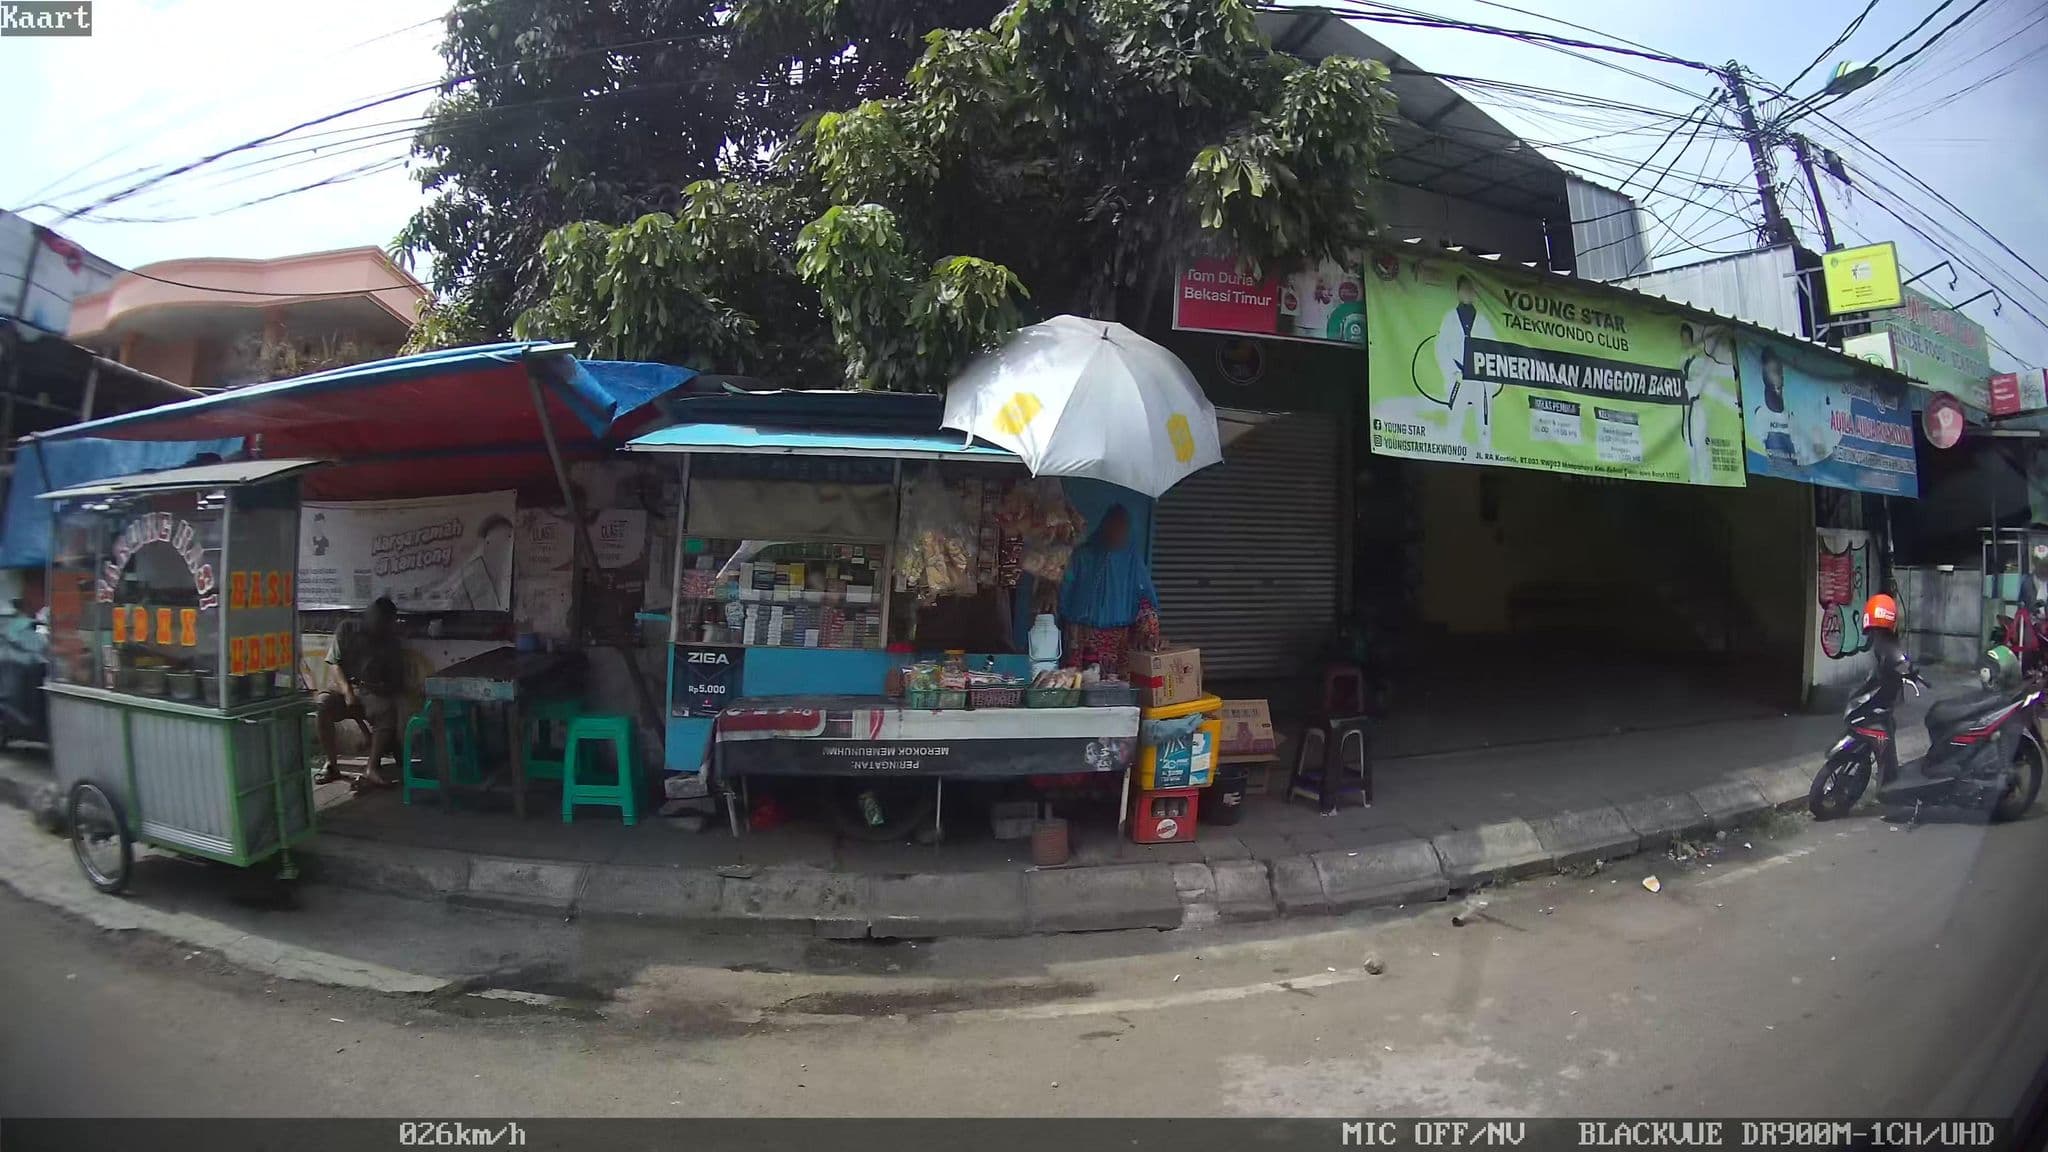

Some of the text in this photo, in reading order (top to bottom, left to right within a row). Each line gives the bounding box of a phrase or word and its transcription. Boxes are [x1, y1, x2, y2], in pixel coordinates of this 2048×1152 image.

[1187, 268, 1215, 283] Tom
[1184, 286, 1272, 306] Bekasi Timur
[1503, 288, 1627, 334] YOUNG STAR
[1501, 312, 1629, 352] TAEKWONDO CLUB
[1473, 351, 1682, 398] PENERIMAAN ANGGOTA BARU
[1383, 422, 1426, 436] YOUNG STAR
[1384, 438, 1468, 457] YOUNGSTARTAEKWONDO
[687, 651, 730, 665] ZIGA
[688, 684, 726, 695] Rp5.000
[898, 746, 950, 756] MEROKOK
